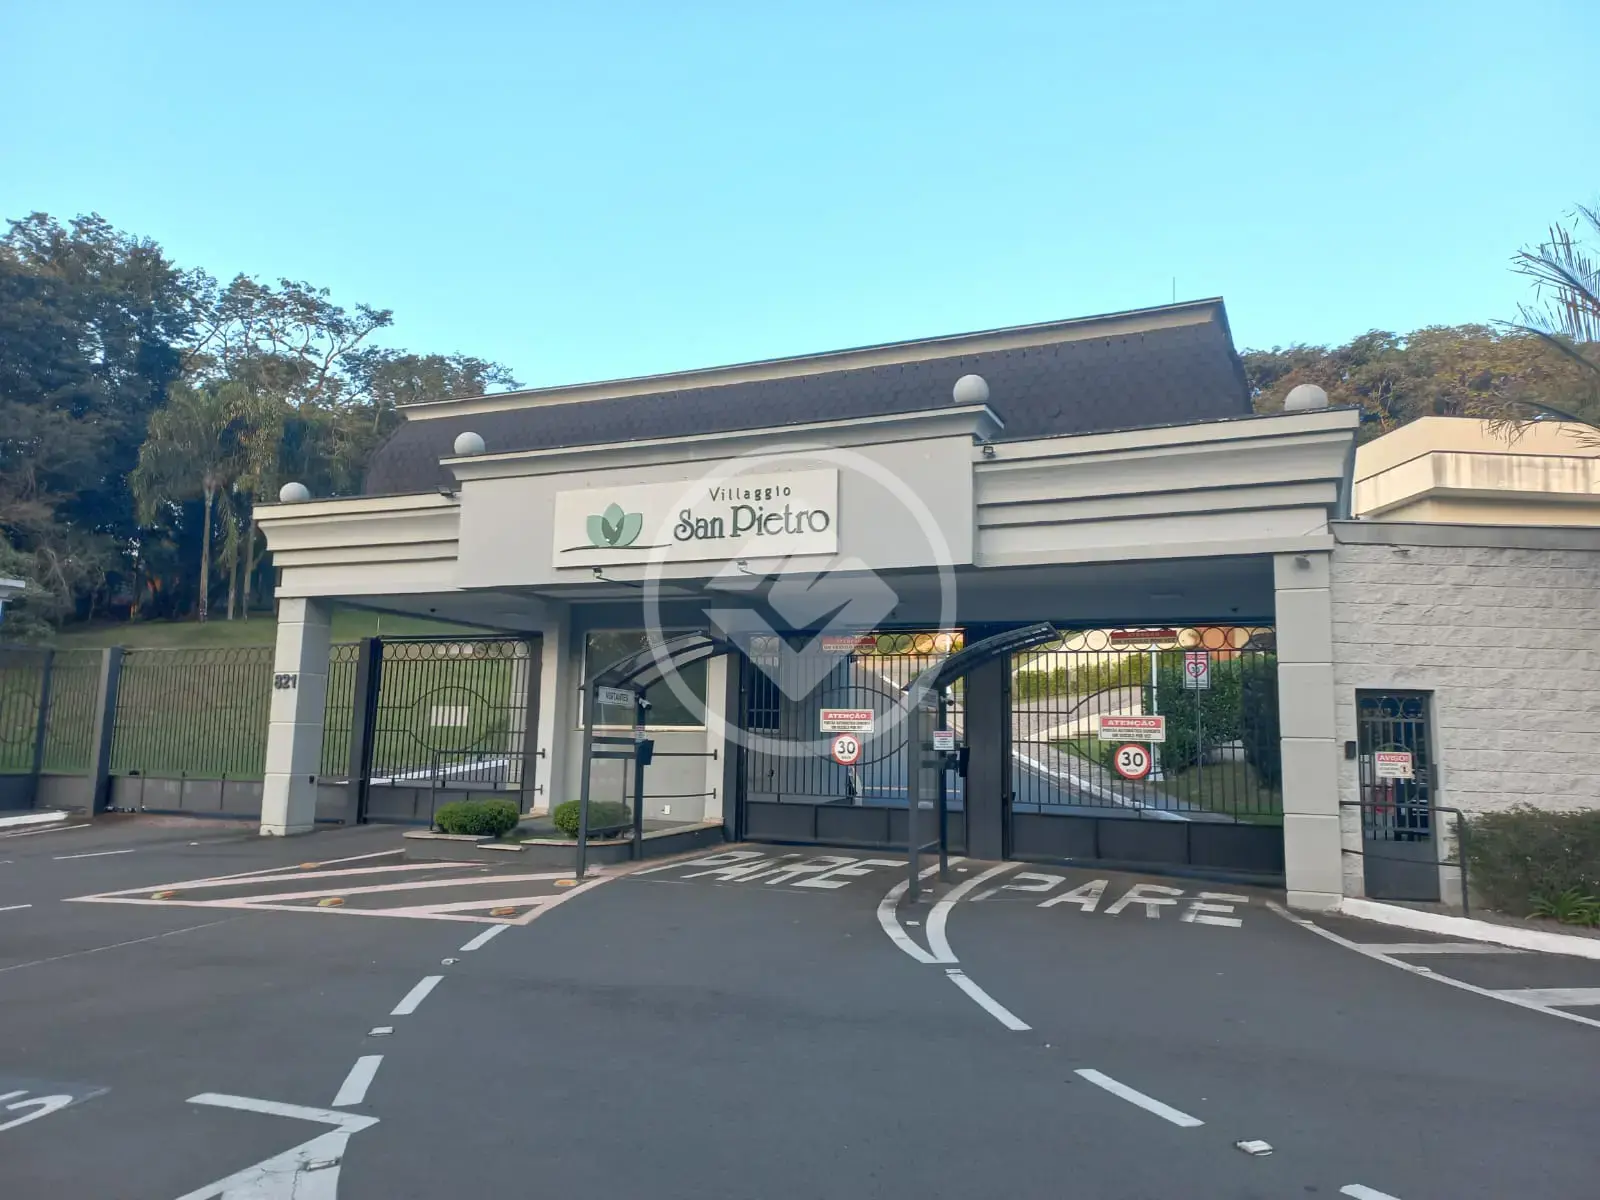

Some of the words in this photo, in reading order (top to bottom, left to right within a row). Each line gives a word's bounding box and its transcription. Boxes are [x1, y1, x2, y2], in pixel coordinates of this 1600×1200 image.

[709, 485, 791, 501] Villaggio
[673, 508, 725, 541] San
[730, 504, 830, 538] Pietro
[827, 712, 867, 720] ATENÇÃO
[1107, 719, 1156, 727] ATENÇÃO
[838, 741, 856, 754] 30
[1121, 752, 1144, 767] 30
[969, 871, 1249, 928] PARE
